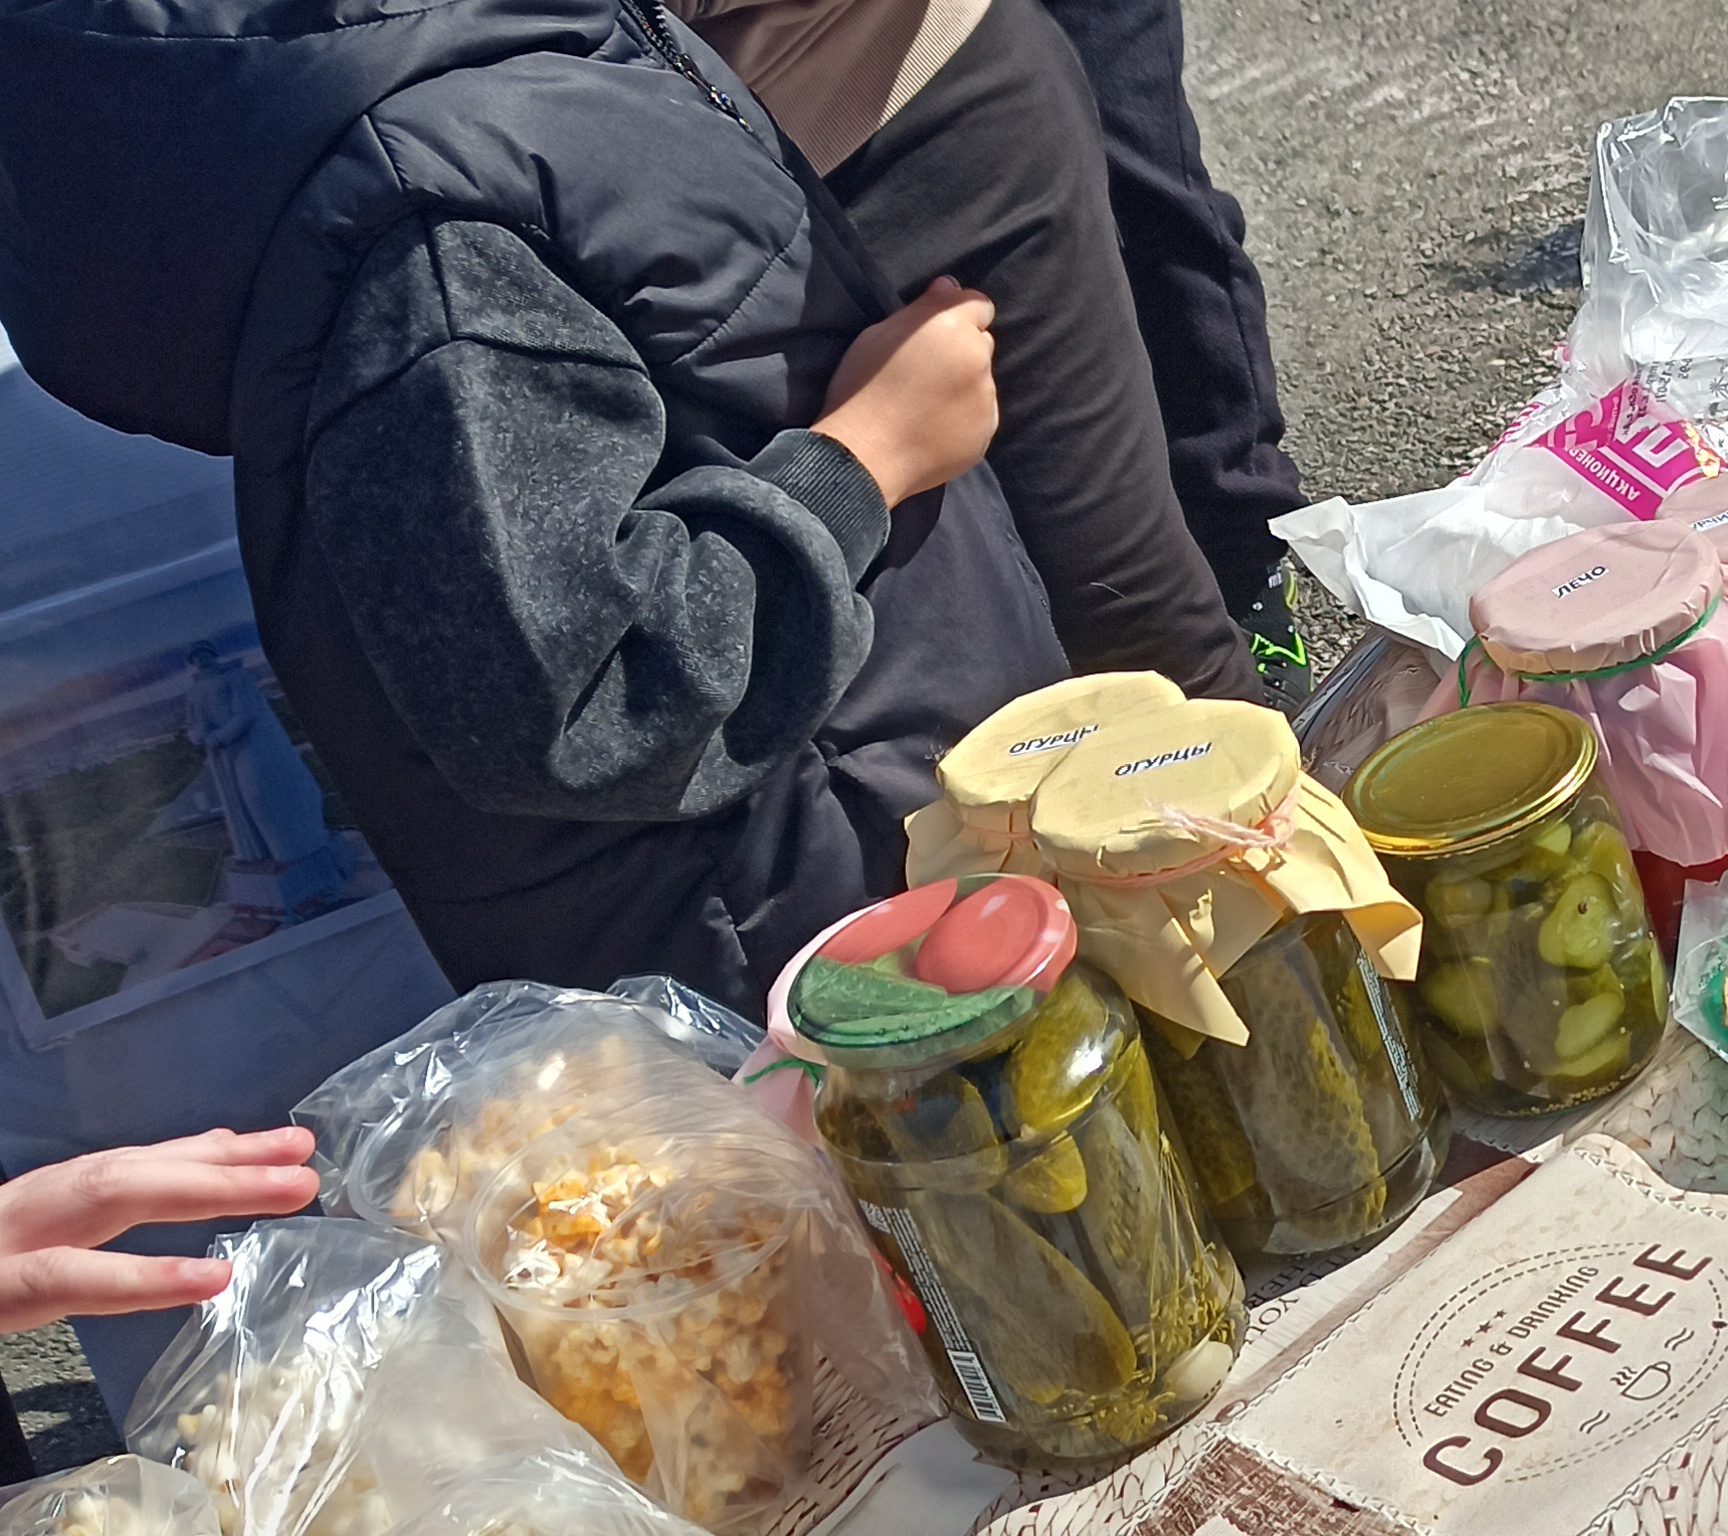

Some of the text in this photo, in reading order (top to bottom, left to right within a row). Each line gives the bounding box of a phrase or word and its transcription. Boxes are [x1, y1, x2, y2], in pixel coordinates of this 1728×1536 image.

[1566, 446, 1642, 502] АКЦИОНЕР
[1557, 565, 1607, 598] ЛЕЧО
[1114, 741, 1213, 777] ОГУРЦЫ
[1421, 1242, 1715, 1487] COFFEE
[1423, 1265, 1600, 1418] EATING & DRINKING
